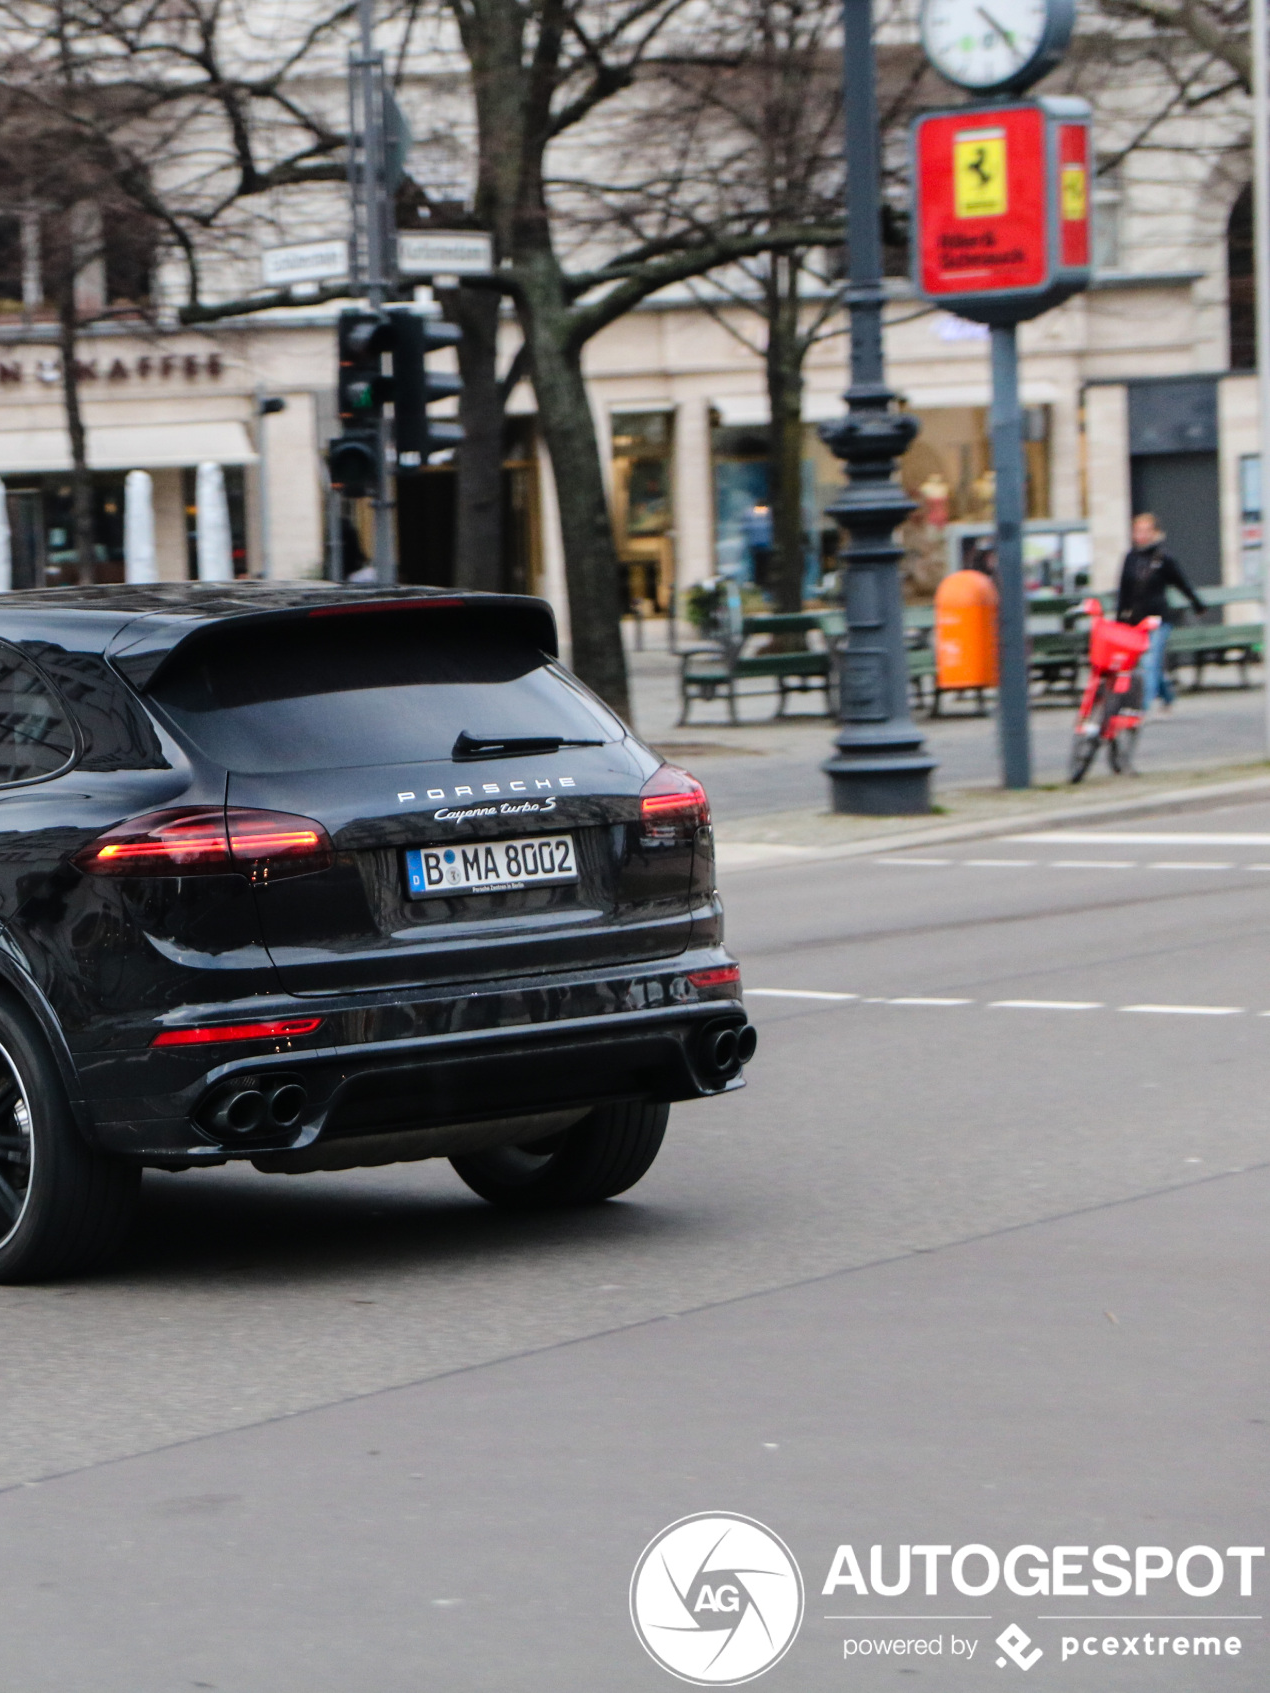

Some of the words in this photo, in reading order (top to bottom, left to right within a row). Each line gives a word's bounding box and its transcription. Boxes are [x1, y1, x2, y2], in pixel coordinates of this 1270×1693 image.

[71, 353, 222, 382] KAFFEE
[397, 776, 576, 803] PORSCHE
[434, 806, 498, 824] Cayenne
[539, 796, 557, 812] S
[424, 852, 444, 886] B
[461, 846, 501, 882] MA
[505, 840, 573, 877] 8002
